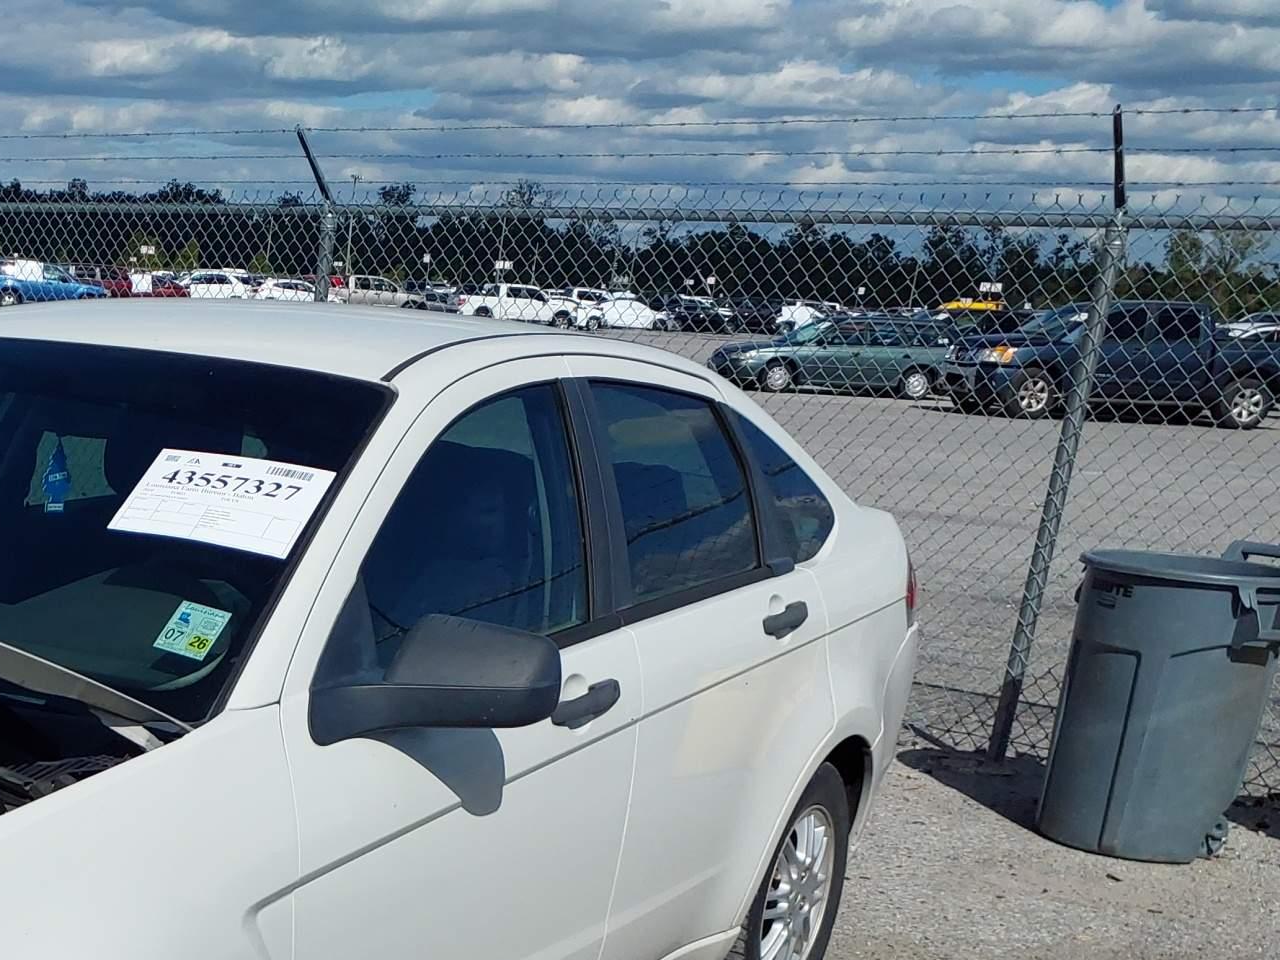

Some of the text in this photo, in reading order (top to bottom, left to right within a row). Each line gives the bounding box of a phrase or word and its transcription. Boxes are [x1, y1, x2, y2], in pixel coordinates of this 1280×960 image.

[161, 469, 303, 501] 43557327
[164, 628, 185, 642] 07
[188, 635, 209, 650] 26
